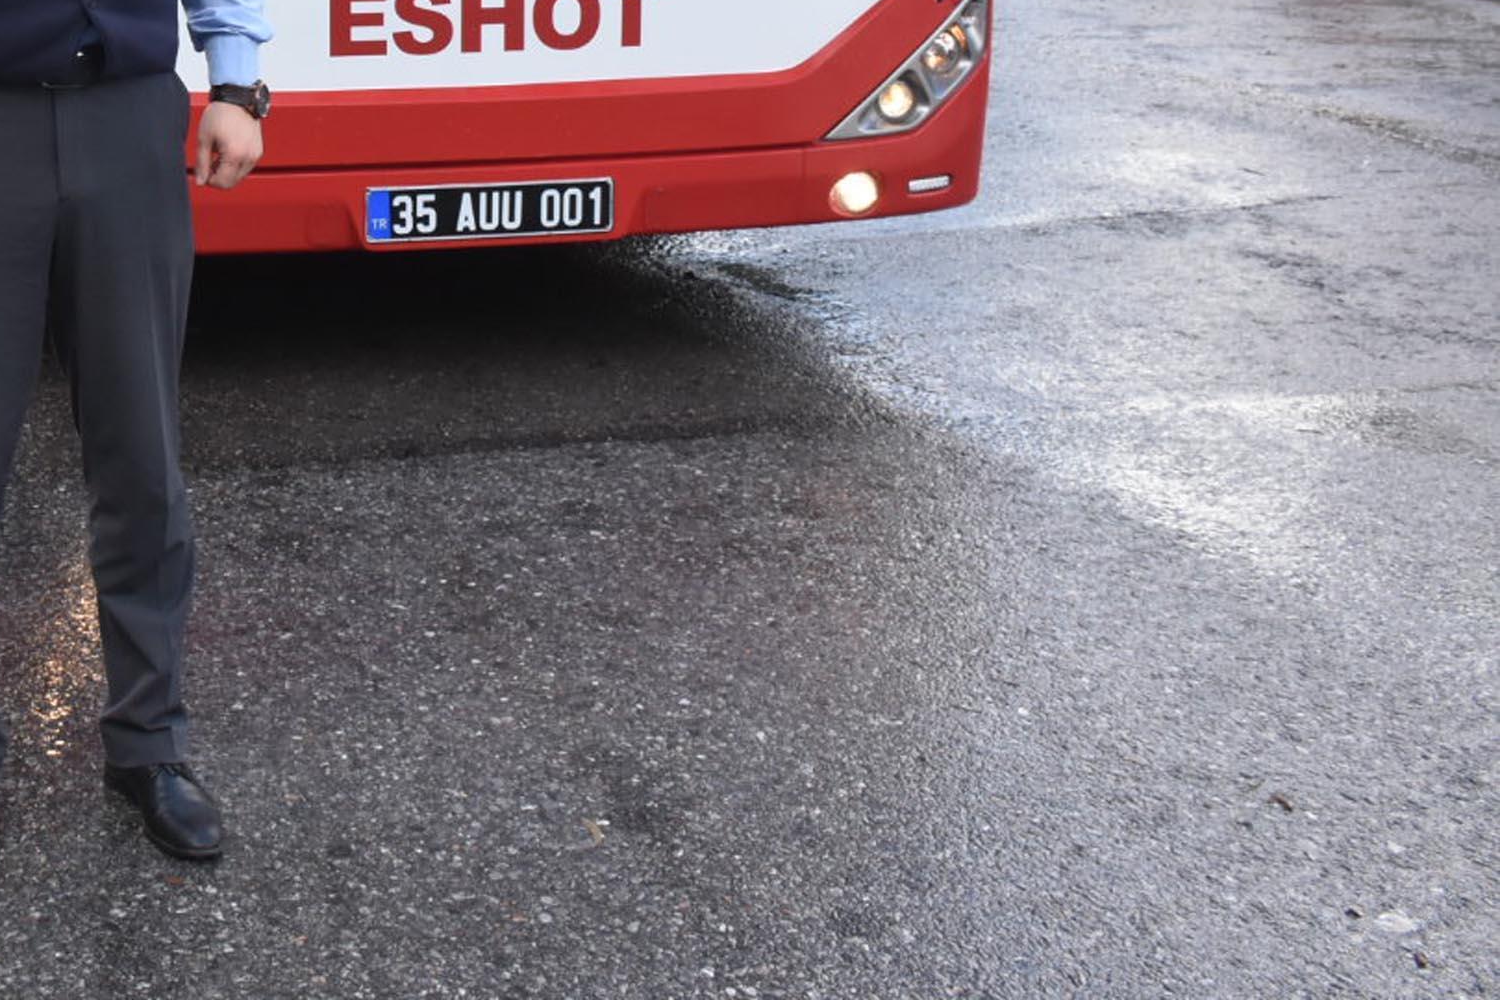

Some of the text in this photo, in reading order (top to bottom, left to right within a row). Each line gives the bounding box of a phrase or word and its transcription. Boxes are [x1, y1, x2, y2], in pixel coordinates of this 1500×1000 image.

[371, 186, 602, 235] TR 35 AUU 001
